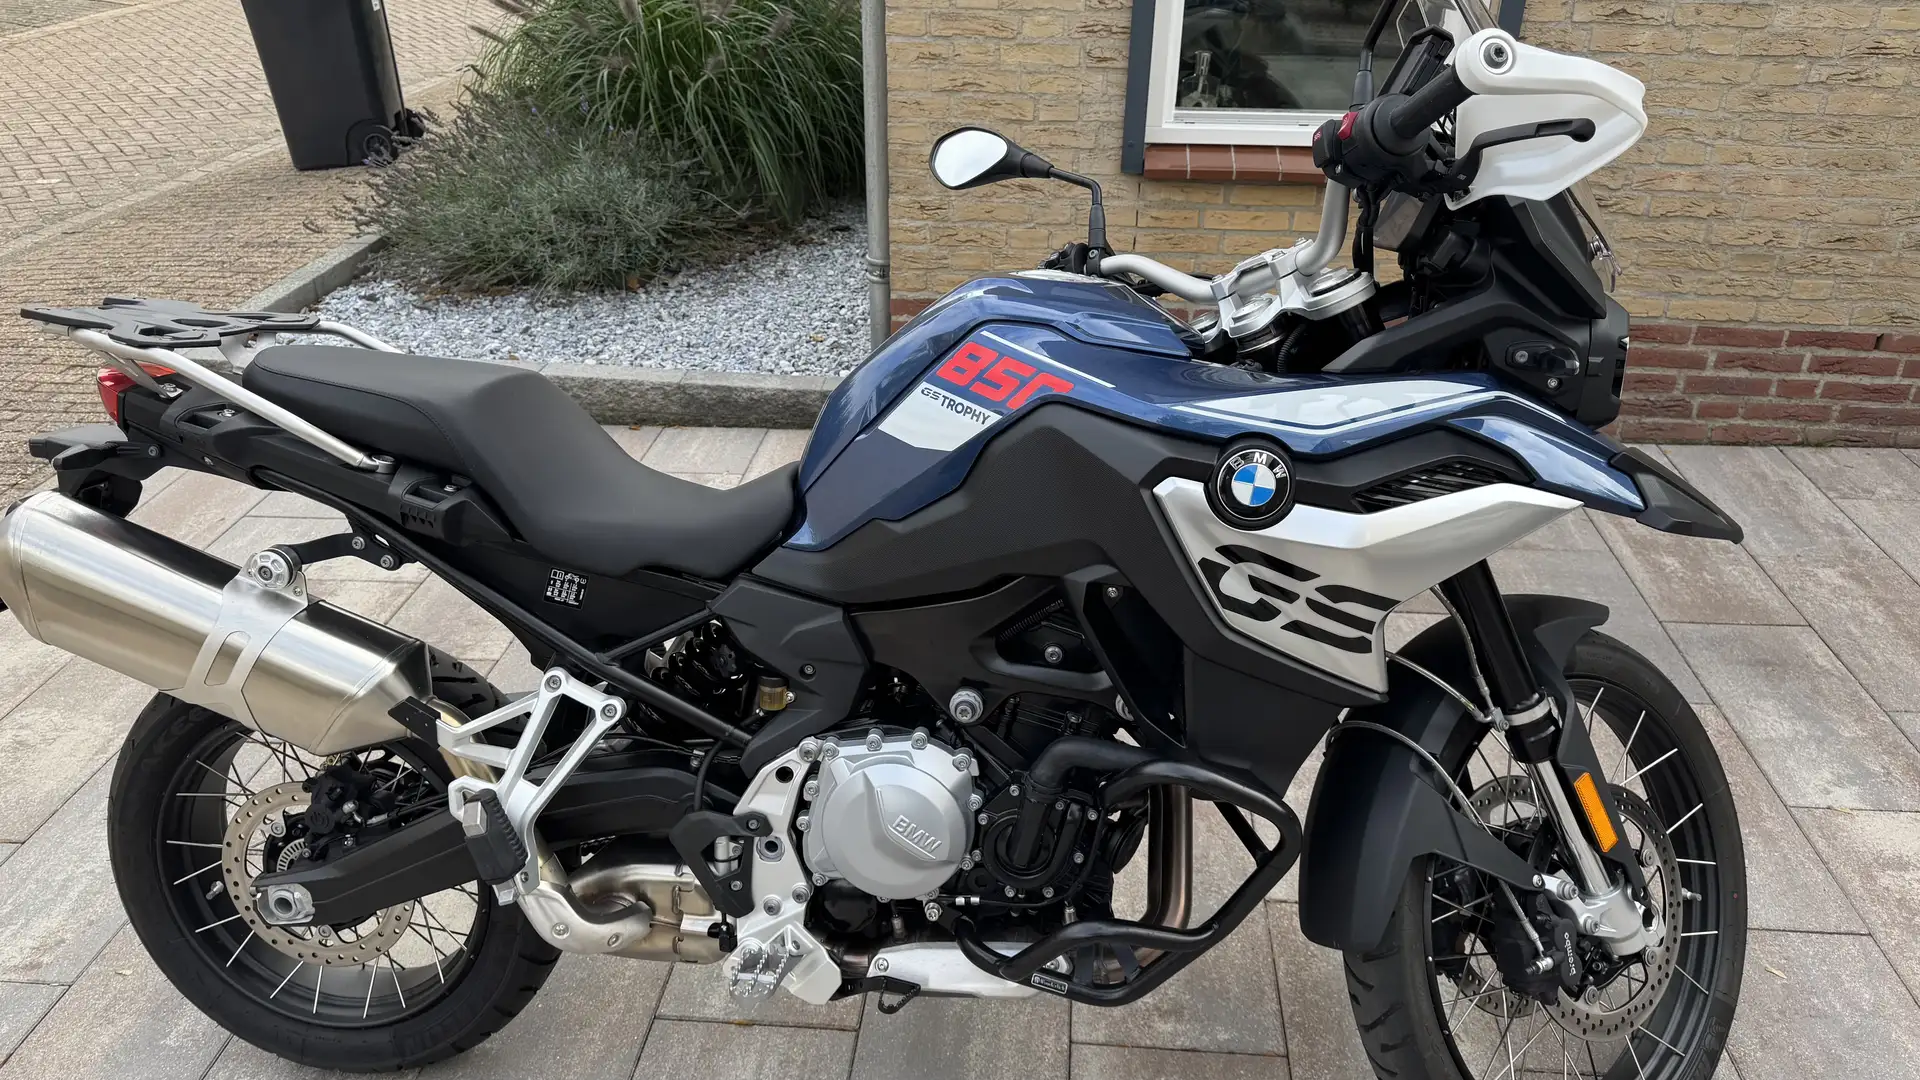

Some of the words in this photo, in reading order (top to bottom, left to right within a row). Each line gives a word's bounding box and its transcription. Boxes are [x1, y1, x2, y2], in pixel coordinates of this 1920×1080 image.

[920, 387, 942, 401] GS
[940, 395, 991, 425] TROPHY
[1229, 451, 1287, 479] BMW
[1198, 544, 1401, 653] GS
[892, 815, 942, 853] BMW
[1564, 932, 1576, 976] brembo
